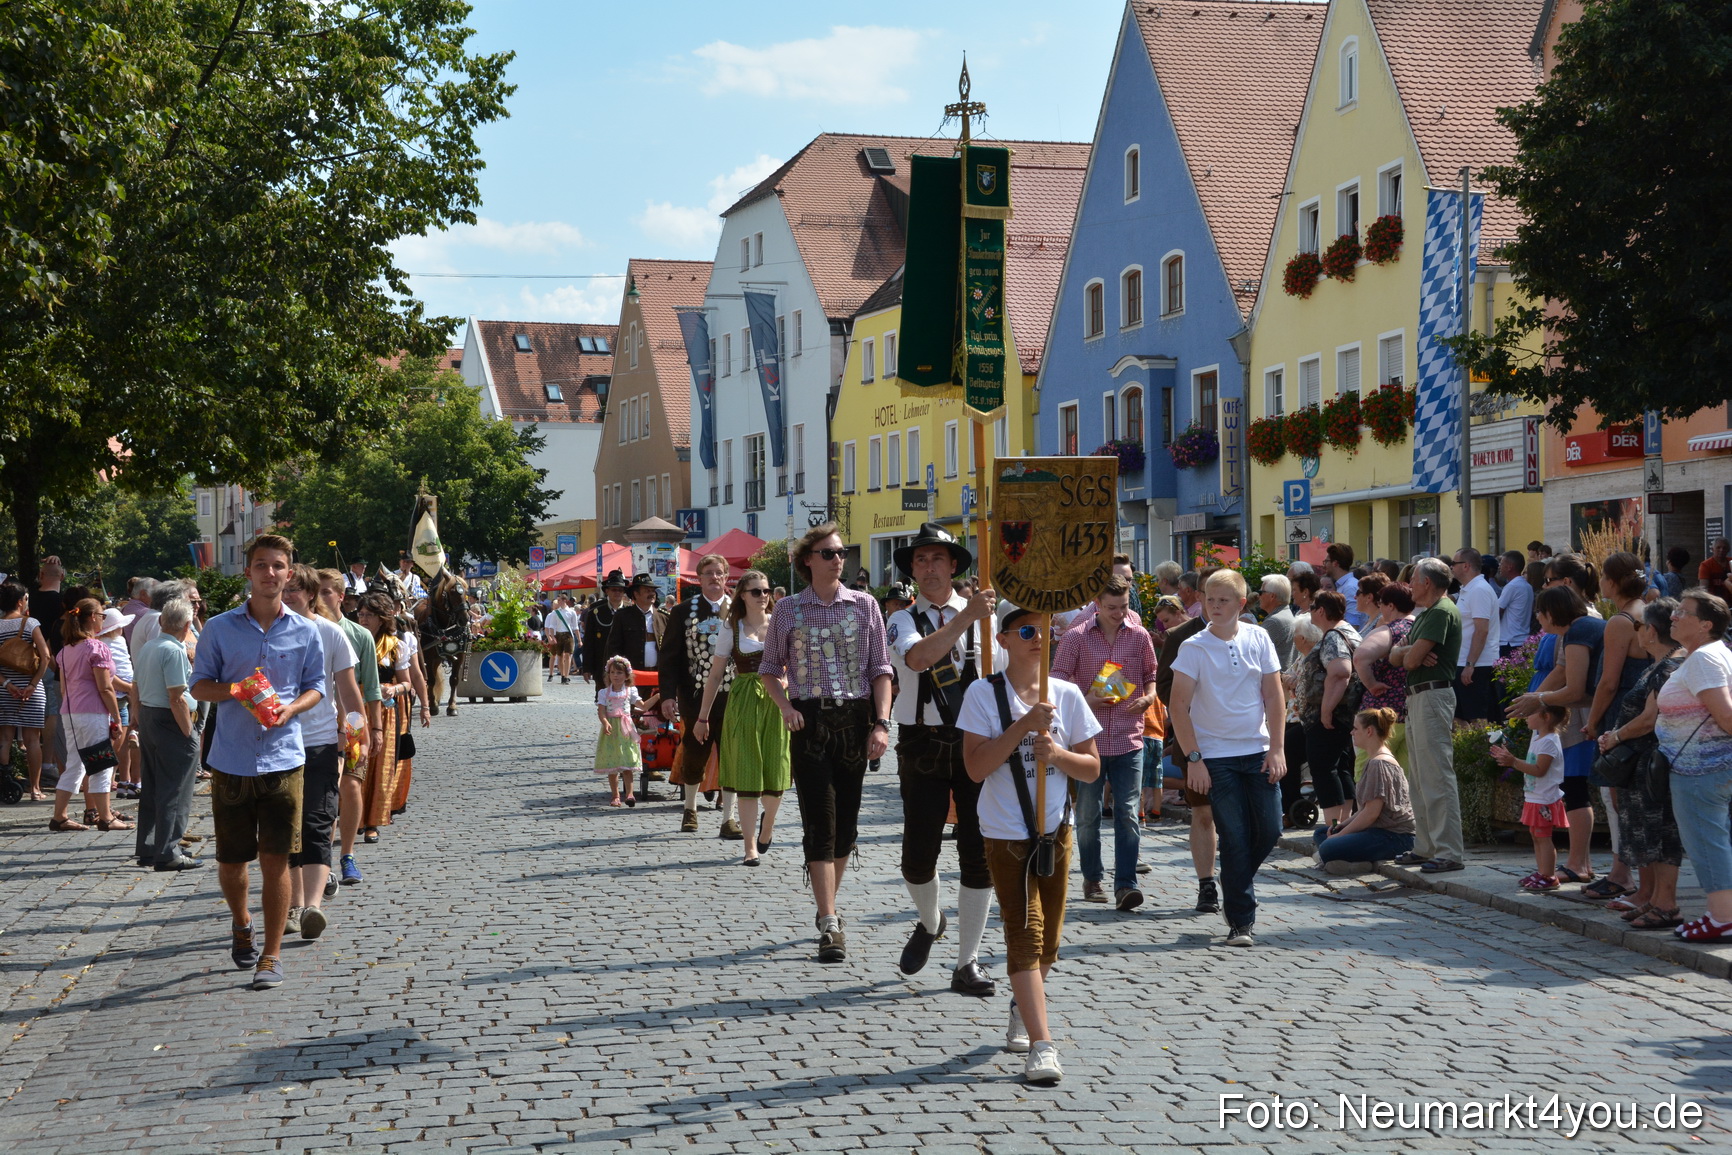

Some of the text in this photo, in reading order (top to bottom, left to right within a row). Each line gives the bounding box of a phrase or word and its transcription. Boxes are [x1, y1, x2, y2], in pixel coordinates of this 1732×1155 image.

[874, 400, 931, 428] HOTEL Lehmeier
[1612, 434, 1639, 447] DER
[1224, 417, 1239, 488] WITTL
[1473, 448, 1514, 466] RIALTO KINO
[1527, 420, 1537, 486] KINO
[1566, 446, 1582, 461] DER
[873, 512, 906, 529] Restaurant
[1058, 521, 1109, 558] 1433
